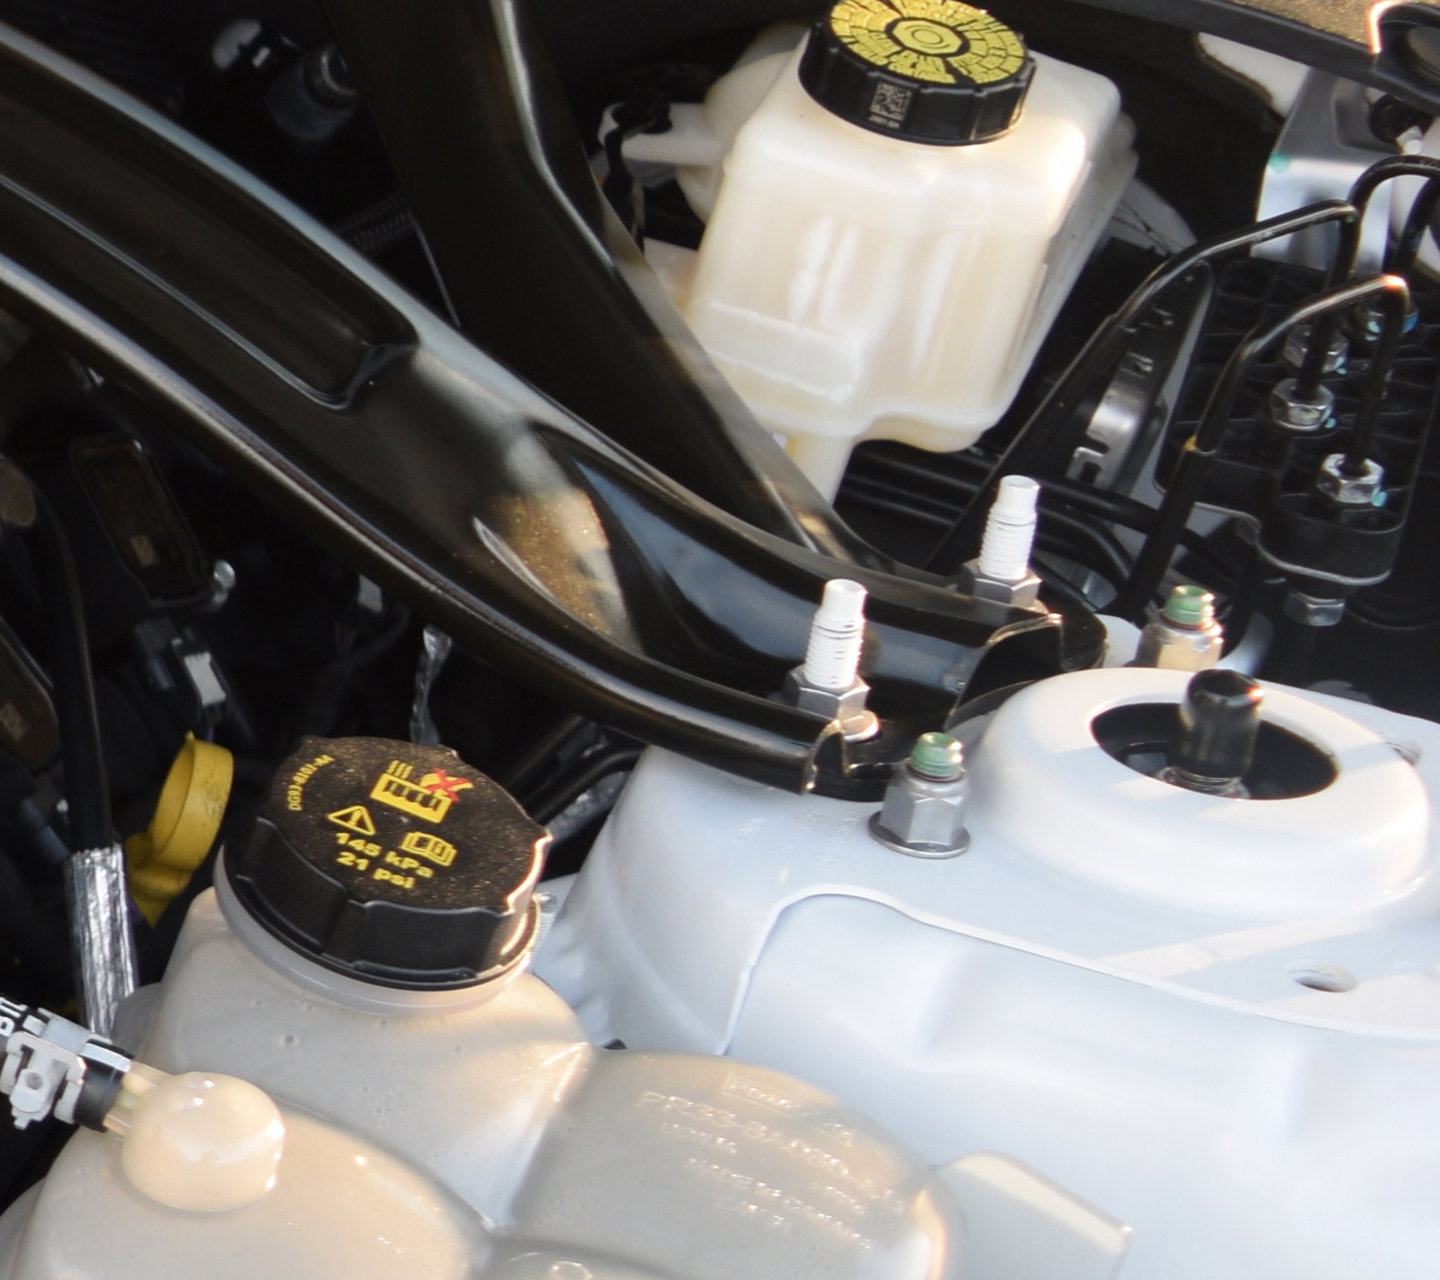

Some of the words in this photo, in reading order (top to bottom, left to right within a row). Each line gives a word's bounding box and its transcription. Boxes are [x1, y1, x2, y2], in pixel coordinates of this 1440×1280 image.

[335, 831, 382, 858] 145
[385, 850, 434, 879] kPa
[336, 851, 370, 871] 21
[373, 867, 416, 890] psi
